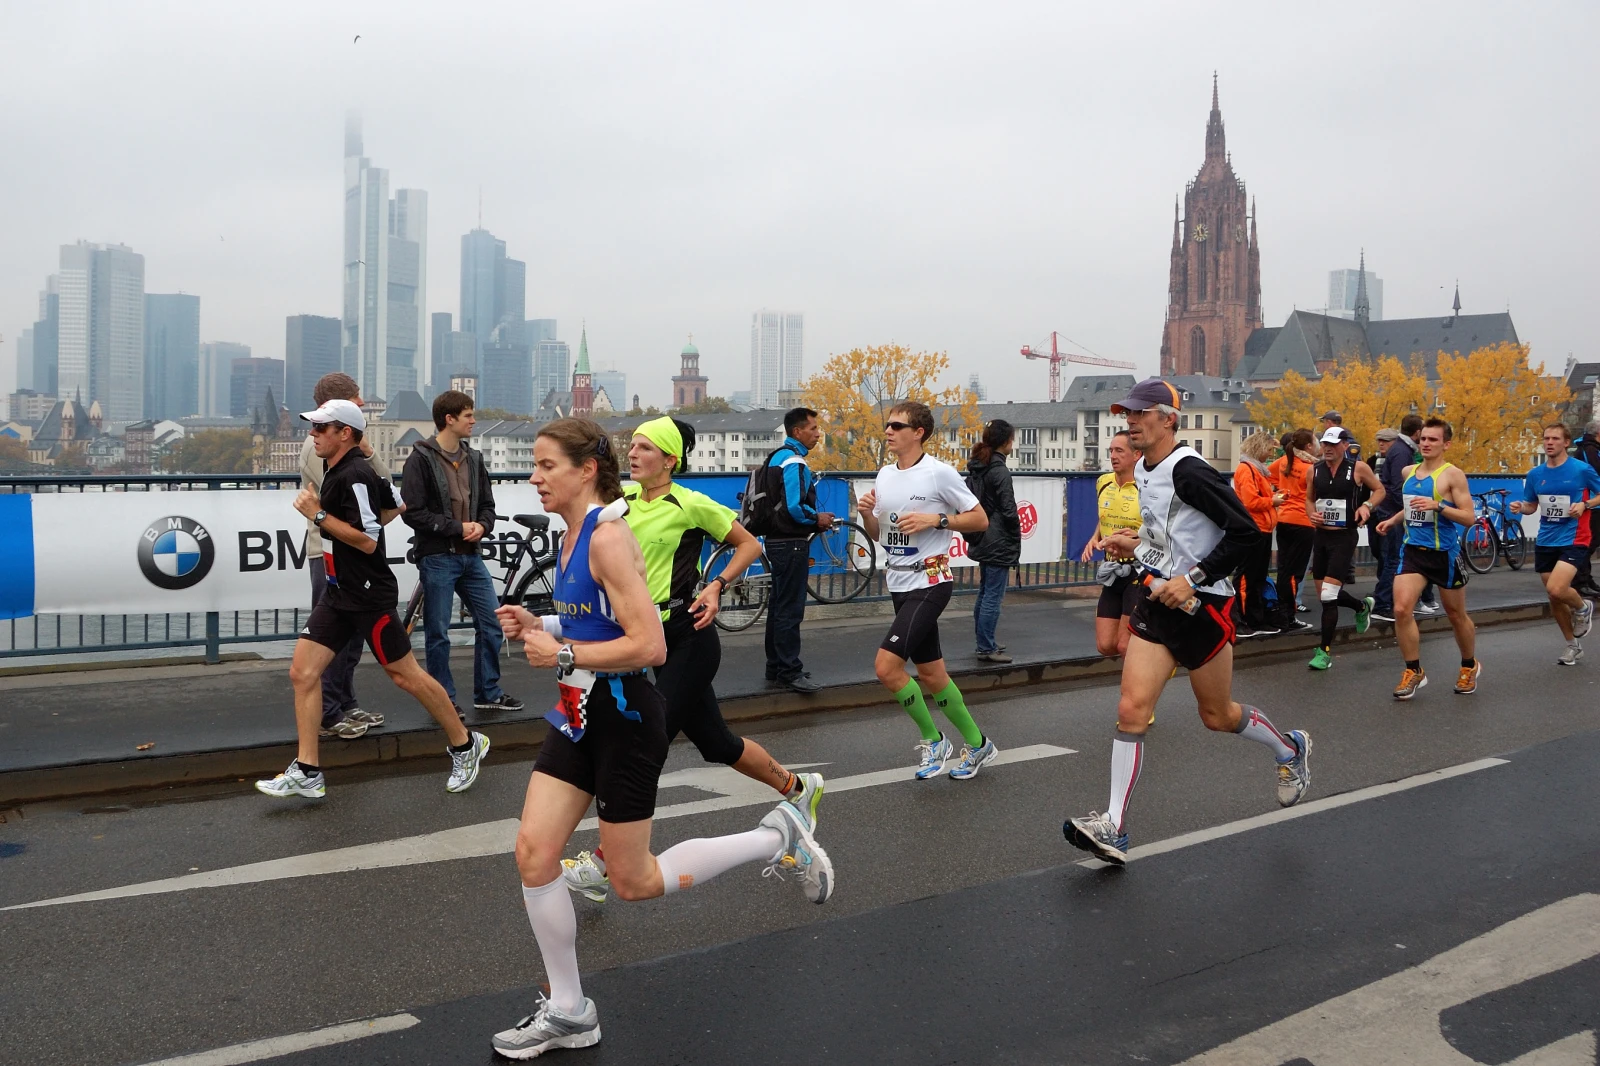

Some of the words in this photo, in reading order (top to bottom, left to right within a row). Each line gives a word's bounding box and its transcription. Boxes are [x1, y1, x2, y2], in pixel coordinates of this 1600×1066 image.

[1410, 511, 1426, 521] 1588
[1546, 508, 1563, 517] 5725
[144, 517, 208, 543] BMW
[887, 532, 910, 546] 8840
[238, 529, 309, 572] BM
